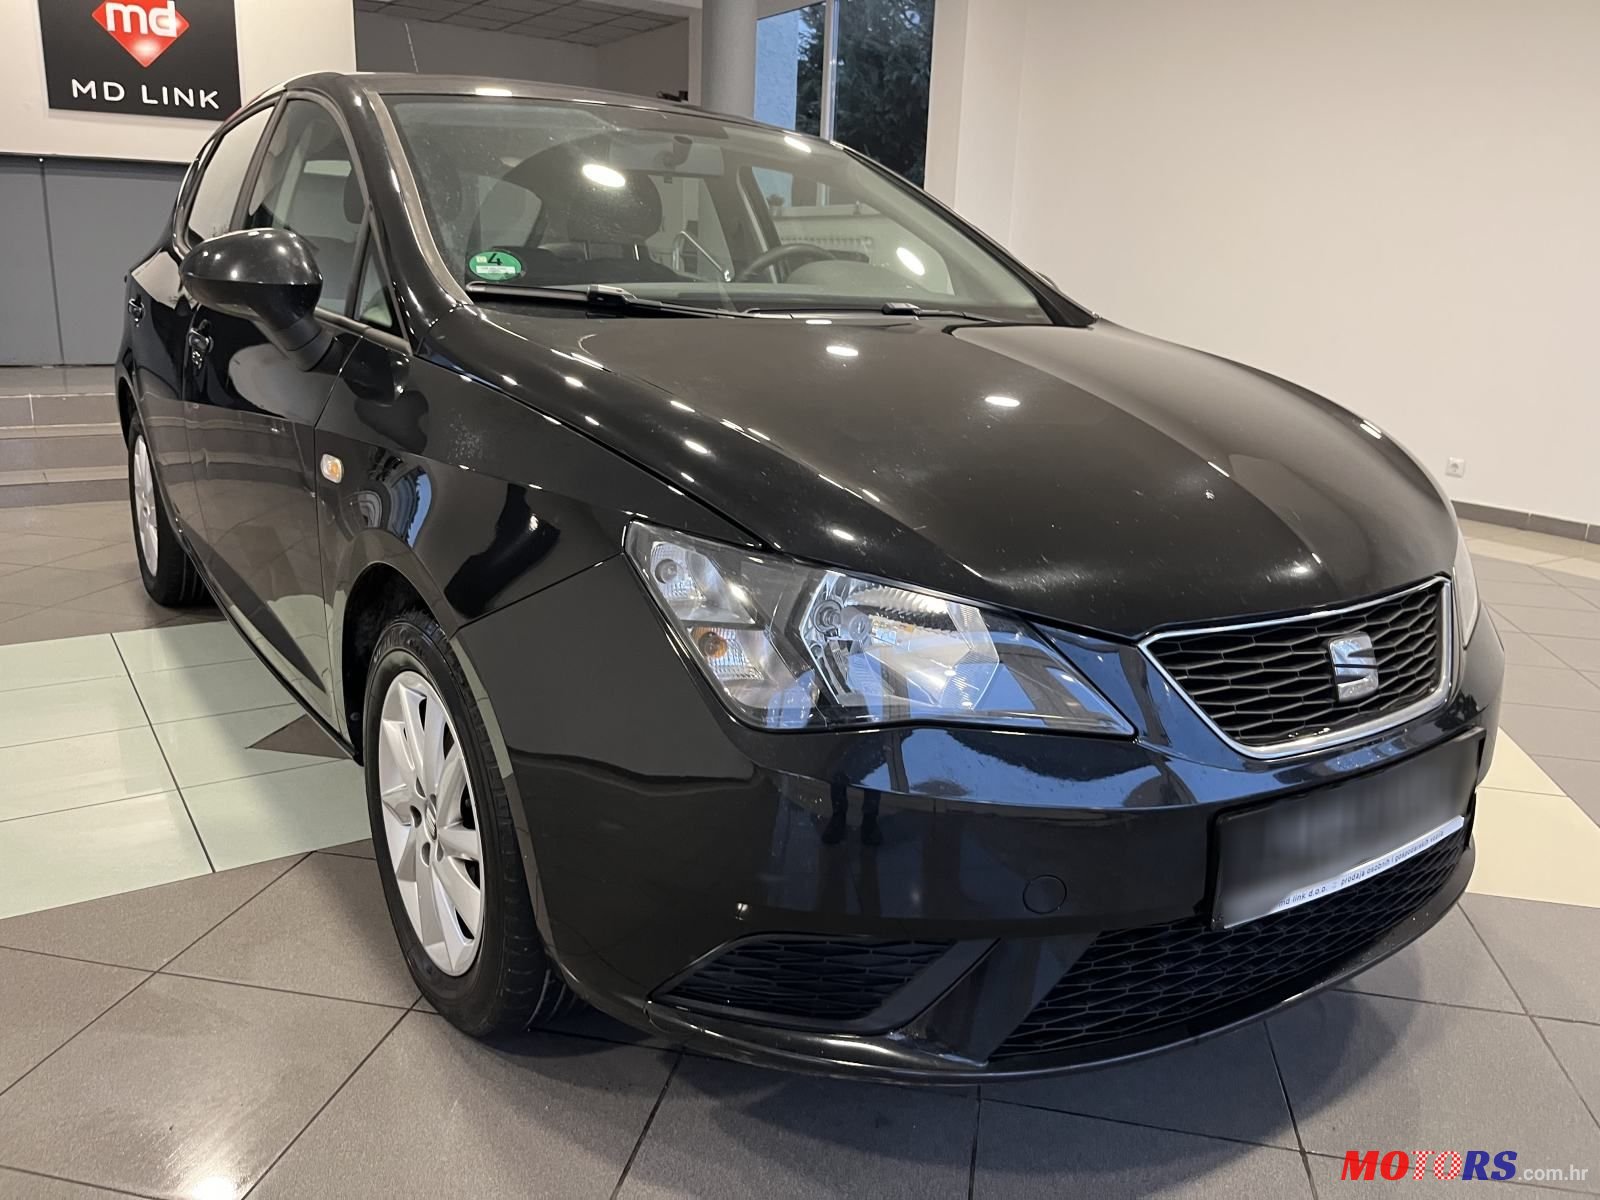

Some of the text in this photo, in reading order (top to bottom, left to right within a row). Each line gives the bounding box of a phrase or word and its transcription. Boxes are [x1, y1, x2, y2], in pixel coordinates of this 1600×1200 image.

[105, 0, 177, 37] md
[71, 78, 219, 109] MD LINK
[487, 253, 503, 266] 4
[1308, 886, 1327, 897] d.o.o.
[1340, 870, 1366, 887] prodaja
